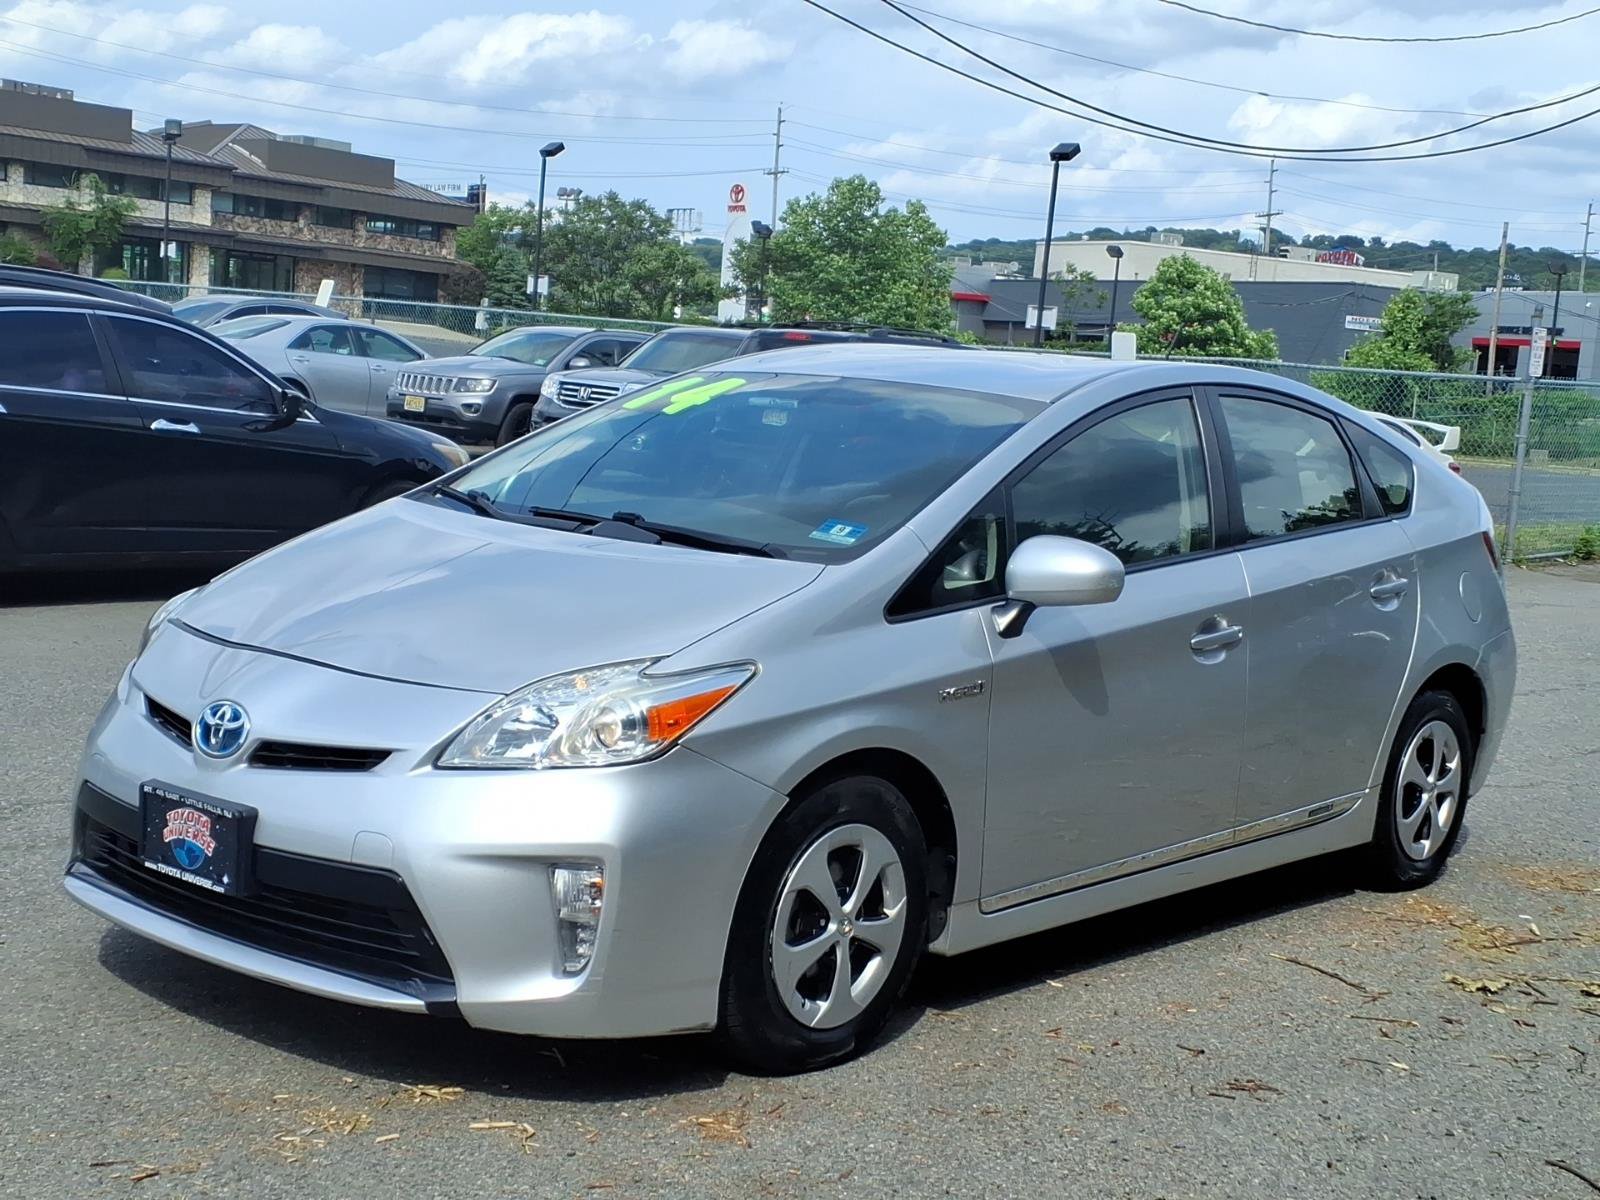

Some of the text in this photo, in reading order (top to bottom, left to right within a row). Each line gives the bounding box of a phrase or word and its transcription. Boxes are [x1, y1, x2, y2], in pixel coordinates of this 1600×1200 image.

[727, 204, 746, 213] TOYOTA
[165, 791, 180, 801] EAST
[184, 797, 203, 809] LITTLE
[166, 808, 211, 835] TOYOTA
[163, 824, 215, 857] UNIVERSE
